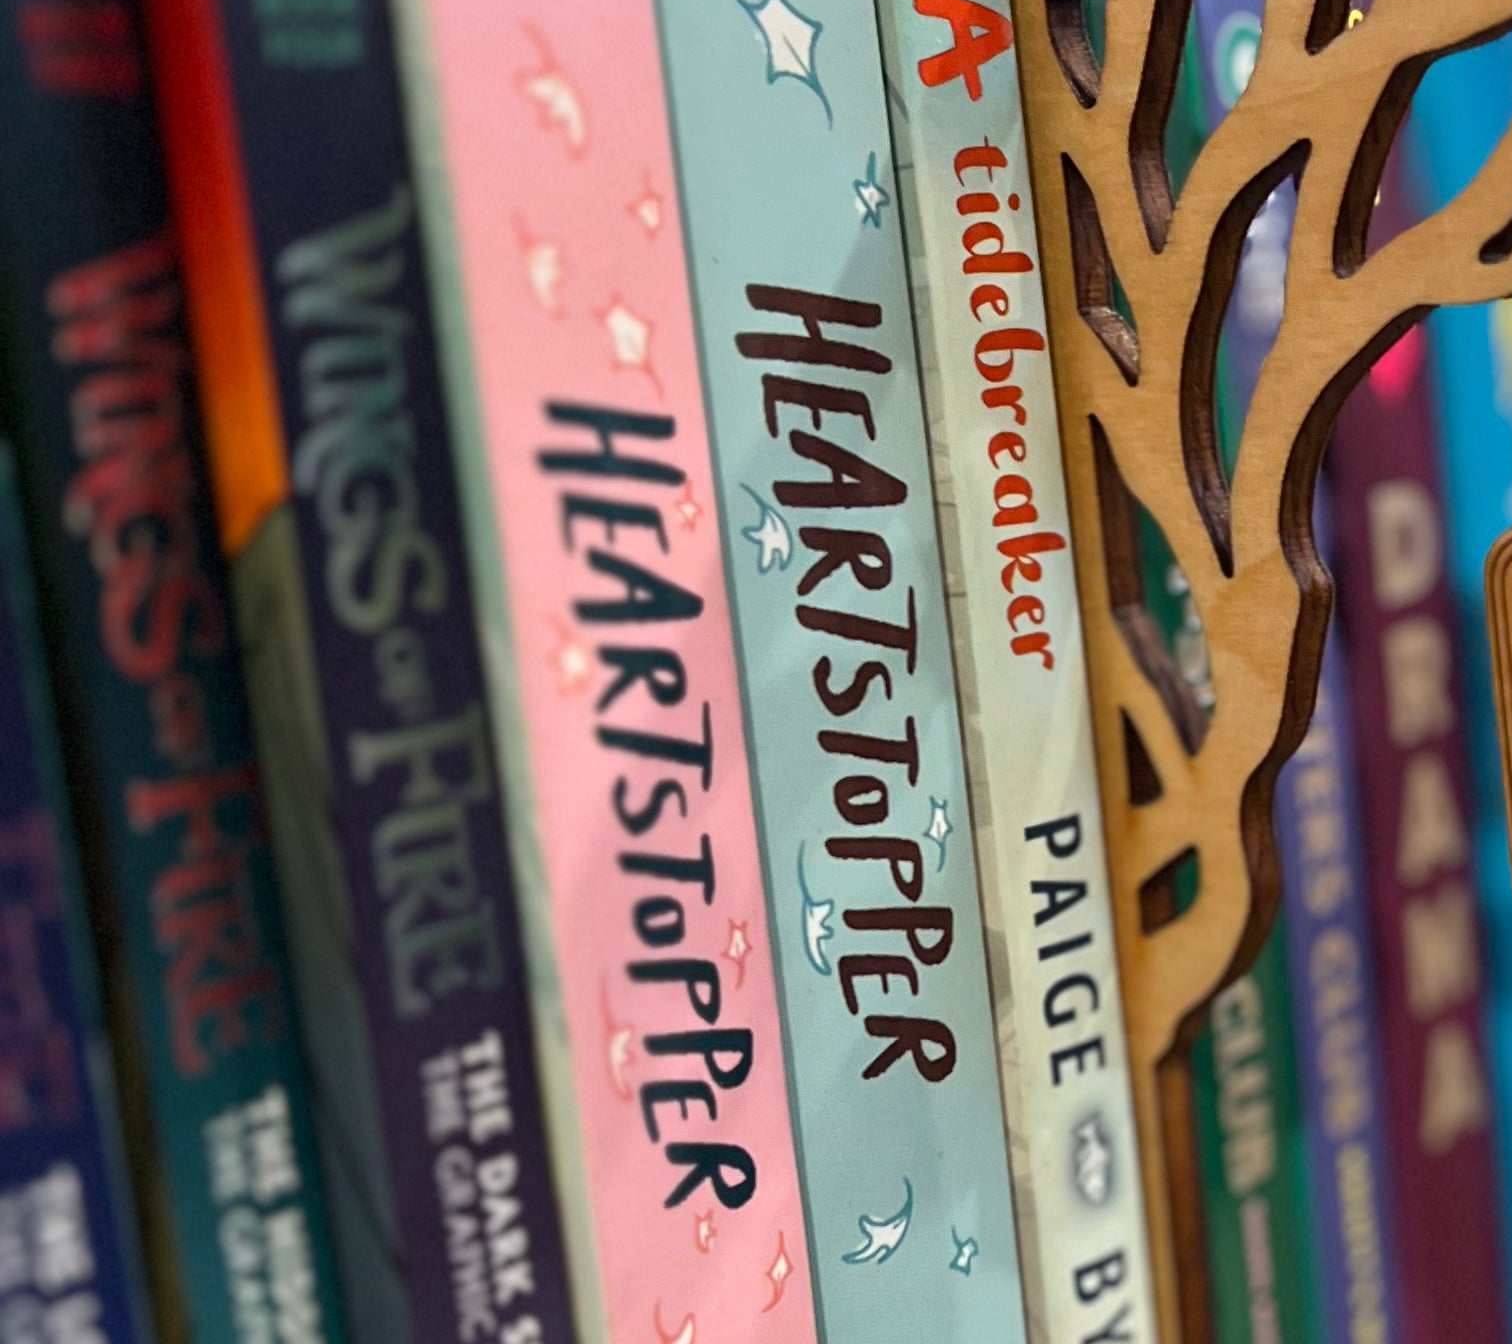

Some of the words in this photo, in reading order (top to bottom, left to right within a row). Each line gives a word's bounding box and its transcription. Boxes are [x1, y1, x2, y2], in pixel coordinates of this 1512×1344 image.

[50, 228, 222, 684] WINGS
[275, 178, 450, 634] WINGS
[953, 135, 1067, 671] tidebreaker
[535, 397, 758, 1211] HEARTSTOPPER
[734, 281, 959, 1083] HEARTSTOPPER
[1366, 478, 1489, 1155] DRAMA
[125, 766, 288, 1081] FIRE
[350, 701, 500, 1023] FIRE
[1023, 813, 1107, 1087] PAIGE
[243, 1083, 302, 1205] THE
[419, 1050, 466, 1144] THE
[461, 1028, 514, 1145] THE
[477, 1152, 536, 1306] DARK
[1210, 973, 1277, 1197] CLUB
[433, 1144, 498, 1344] GRAPHIC
